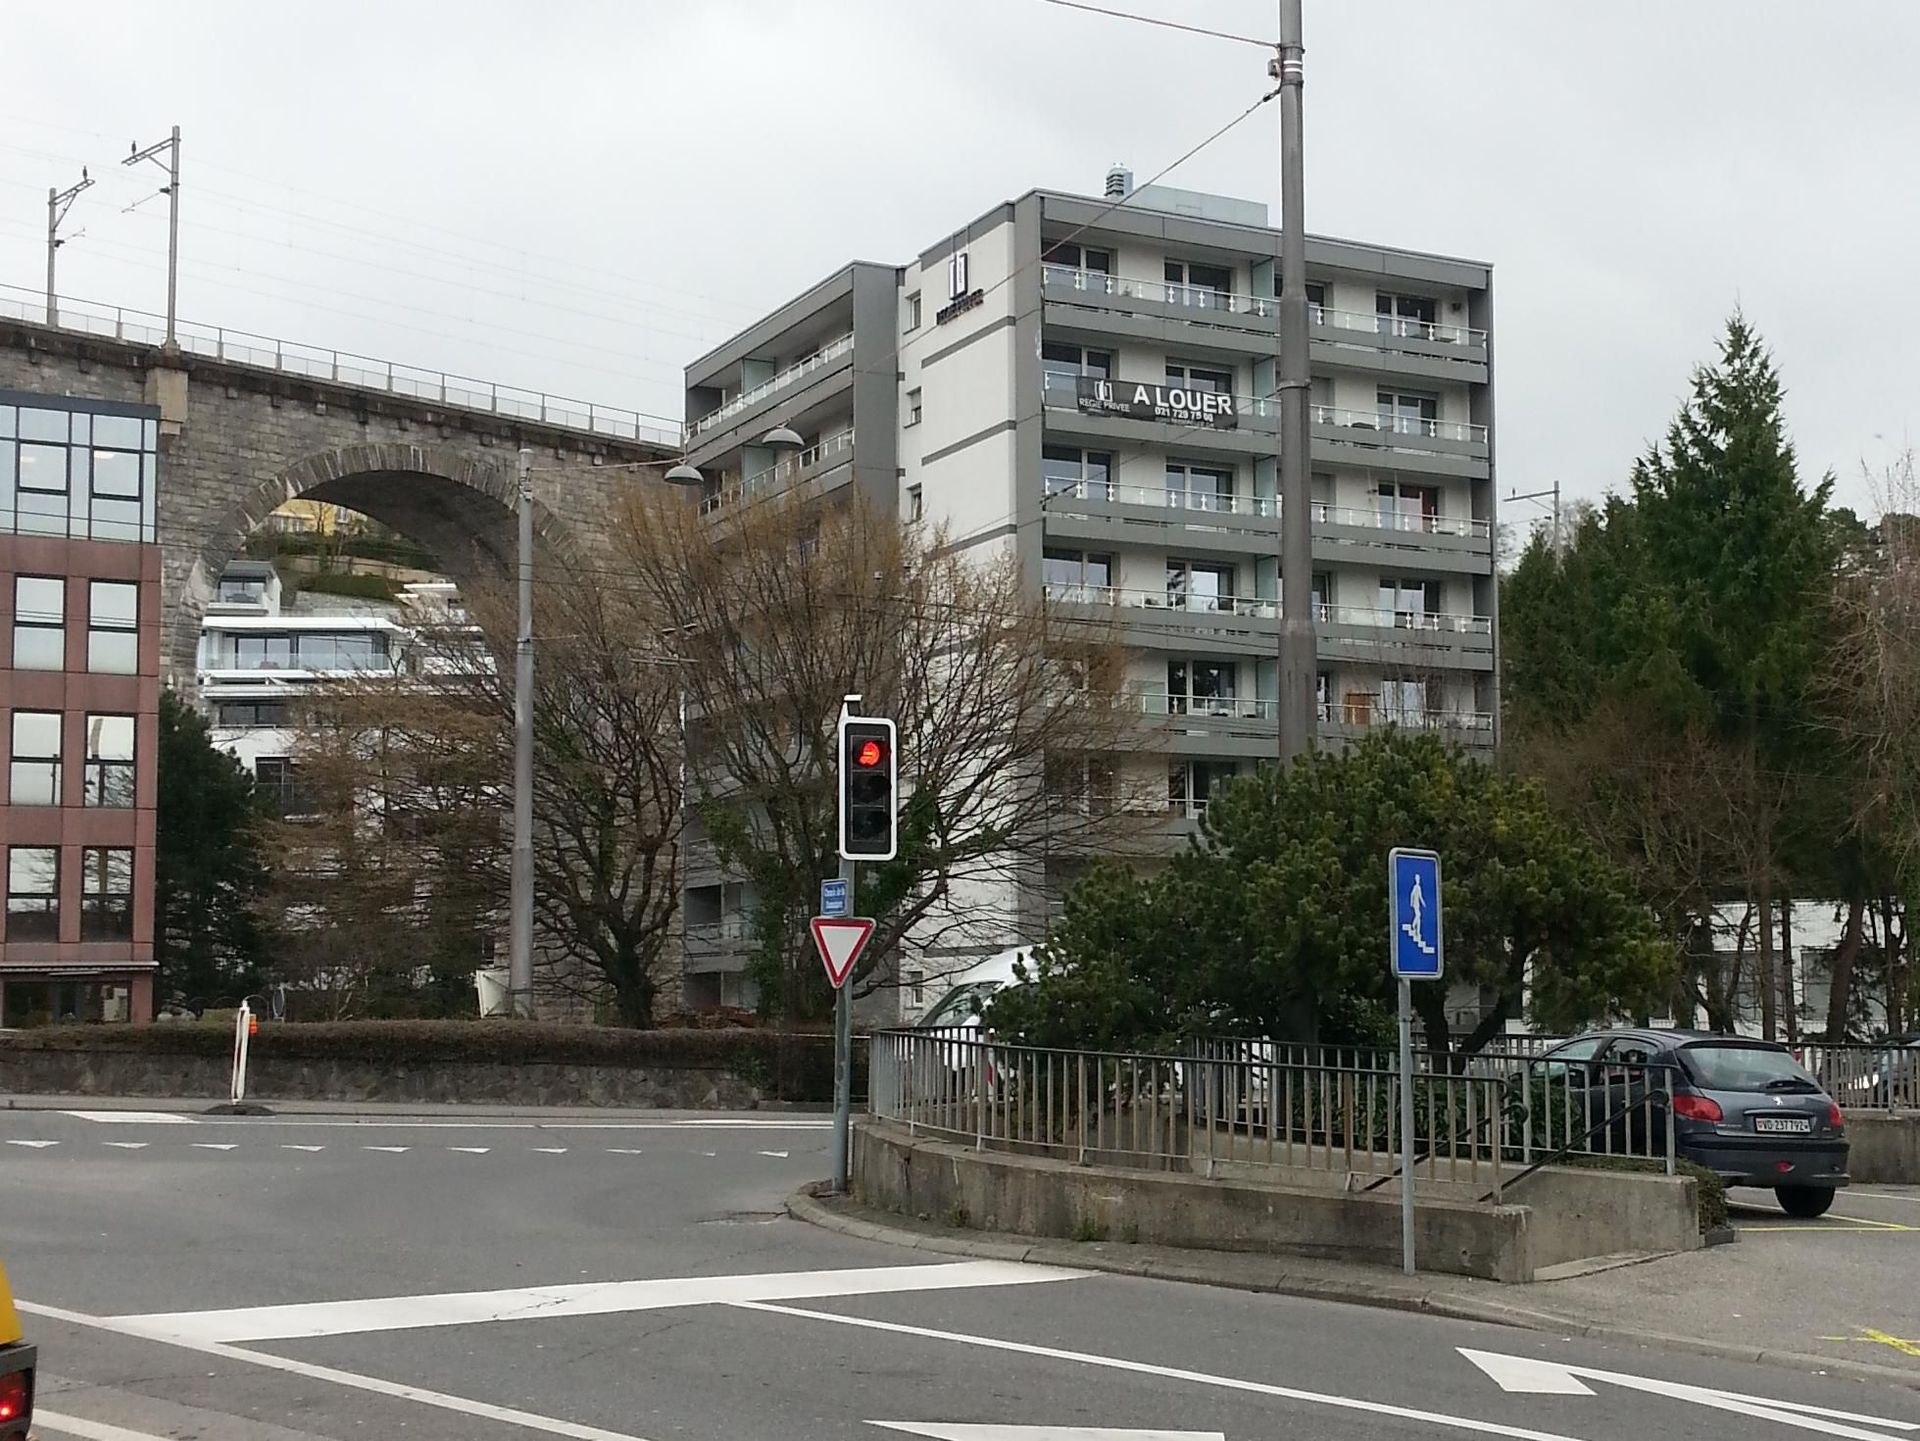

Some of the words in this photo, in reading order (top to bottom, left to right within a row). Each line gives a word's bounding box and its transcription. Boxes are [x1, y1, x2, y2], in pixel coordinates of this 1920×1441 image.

[1133, 385, 1151, 405] A
[1155, 387, 1233, 415] LOUER
[1155, 407, 1171, 416] 021
